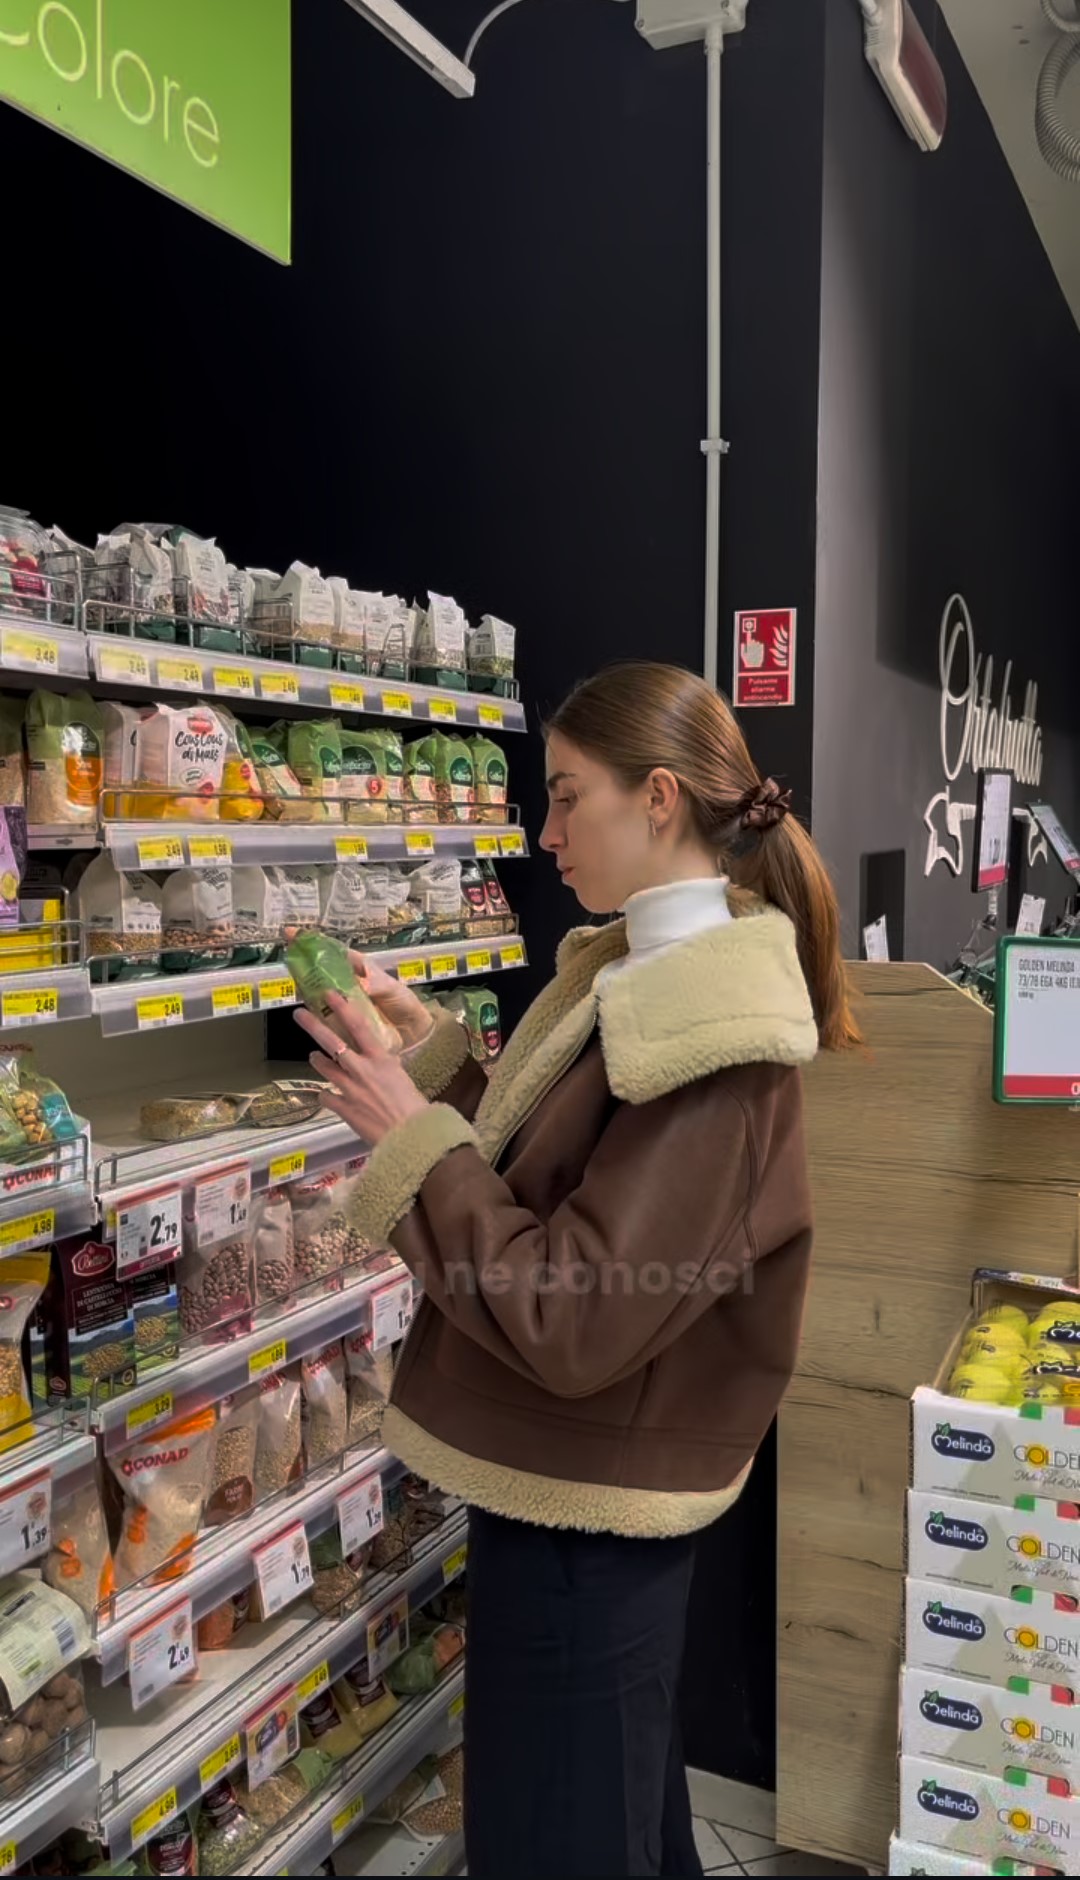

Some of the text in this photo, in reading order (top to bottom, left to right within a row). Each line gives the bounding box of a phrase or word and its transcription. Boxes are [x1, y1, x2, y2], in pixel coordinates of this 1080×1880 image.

[934, 1434, 993, 1454] Melinda
[133, 1447, 189, 1471] CONAD
[1013, 1444, 1080, 1471] GOLDE
[927, 1523, 985, 1544] Melinda
[925, 1613, 982, 1634] Melinda
[1003, 1627, 1078, 1659] GOLDEN
[922, 1702, 979, 1724] Melinda
[1000, 1718, 1075, 1748] GOLDEN
[920, 1791, 976, 1814] Melinda
[997, 1808, 1072, 1840] GOLDEN
